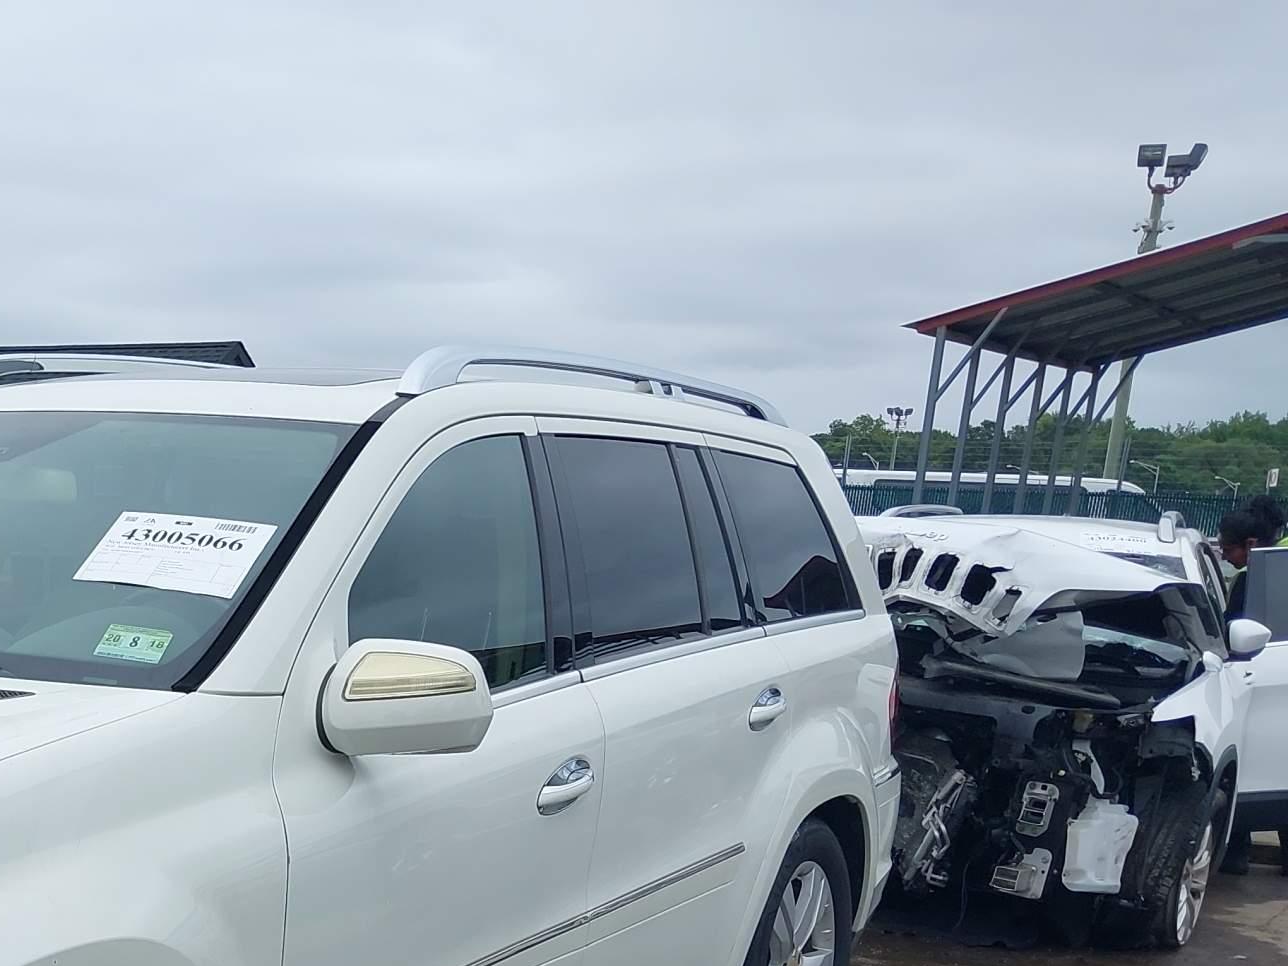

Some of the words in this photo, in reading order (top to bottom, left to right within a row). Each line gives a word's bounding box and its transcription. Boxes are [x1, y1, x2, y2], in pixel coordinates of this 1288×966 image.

[121, 528, 248, 551] 43005066
[105, 633, 121, 643] 20
[129, 636, 141, 648] 8
